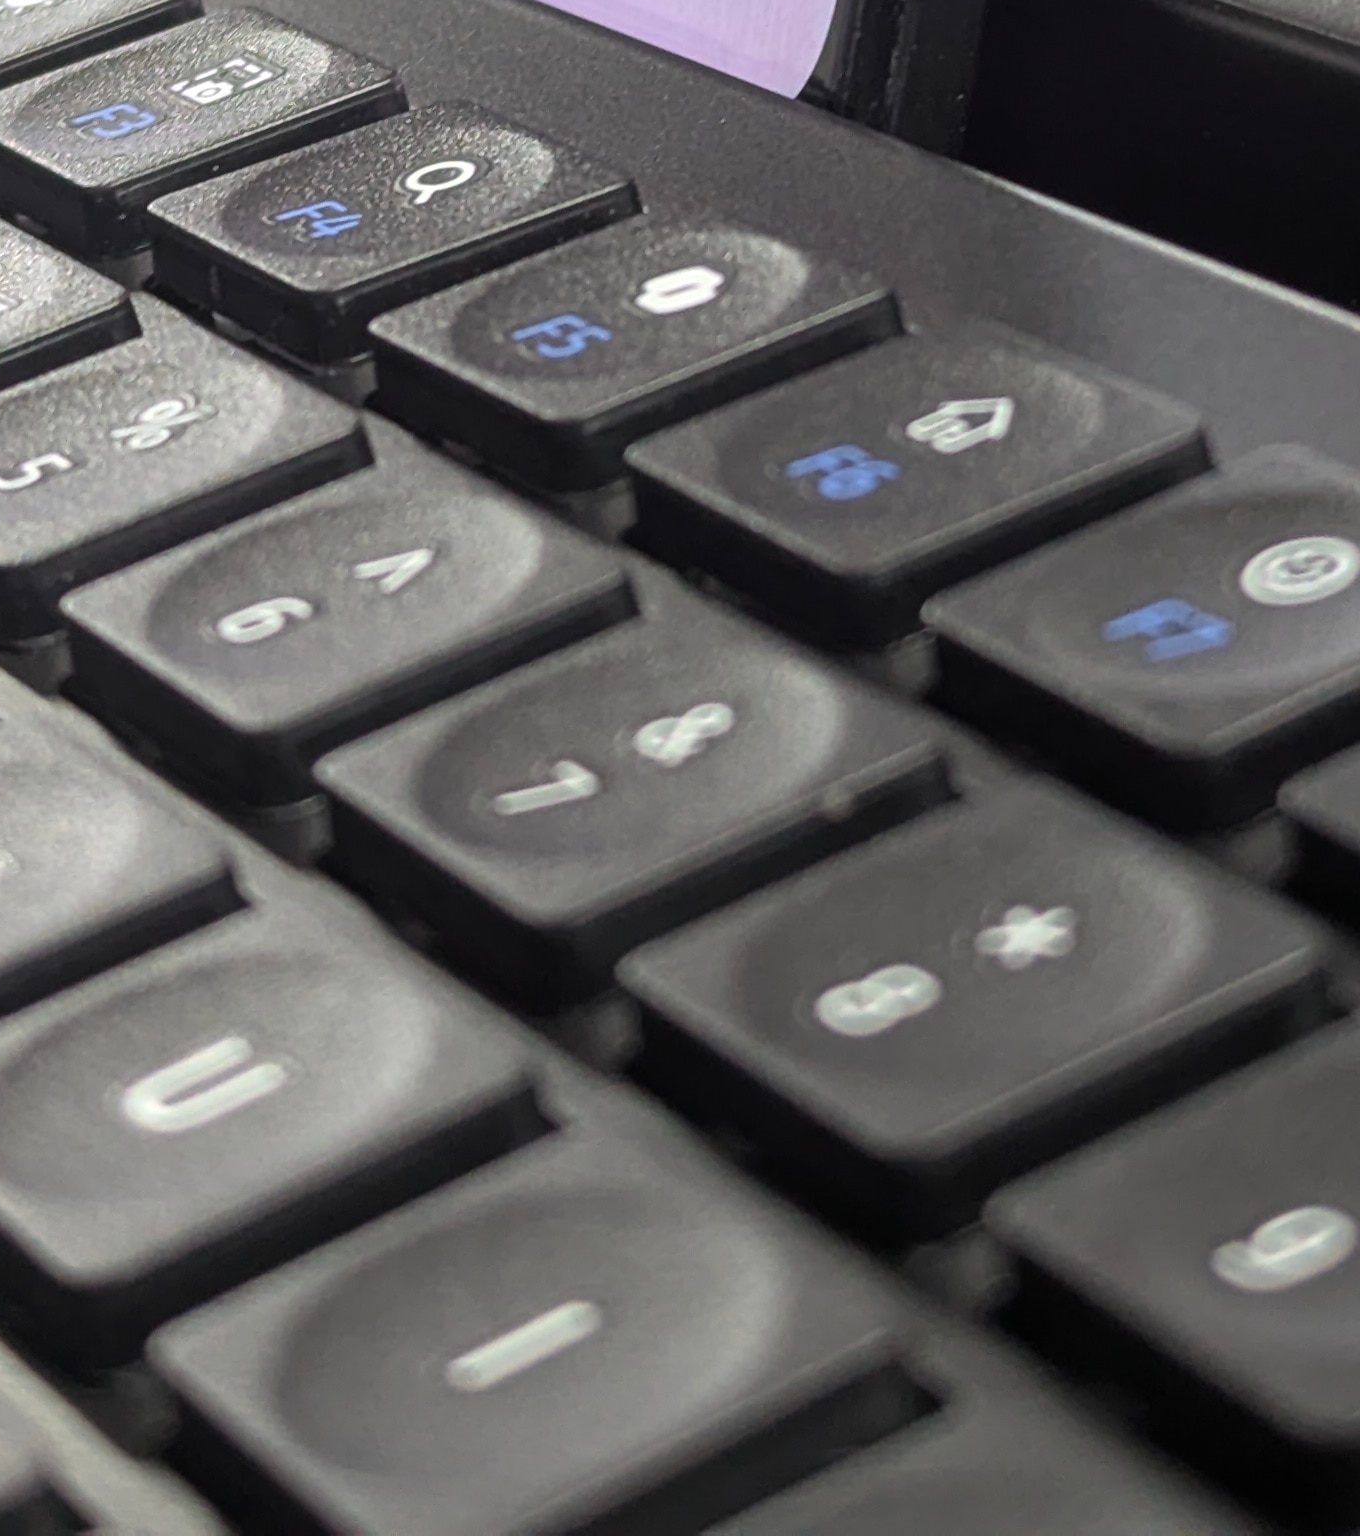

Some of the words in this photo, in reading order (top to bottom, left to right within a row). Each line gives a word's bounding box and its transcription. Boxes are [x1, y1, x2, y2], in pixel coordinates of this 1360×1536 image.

[70, 103, 157, 139] F3
[276, 200, 361, 238] F4
[512, 314, 612, 358] F5
[215, 596, 313, 645] 6
[493, 759, 600, 816] 7
[814, 963, 943, 1037] 8
[120, 1035, 290, 1134] U
[1209, 1204, 1360, 1293] 9
